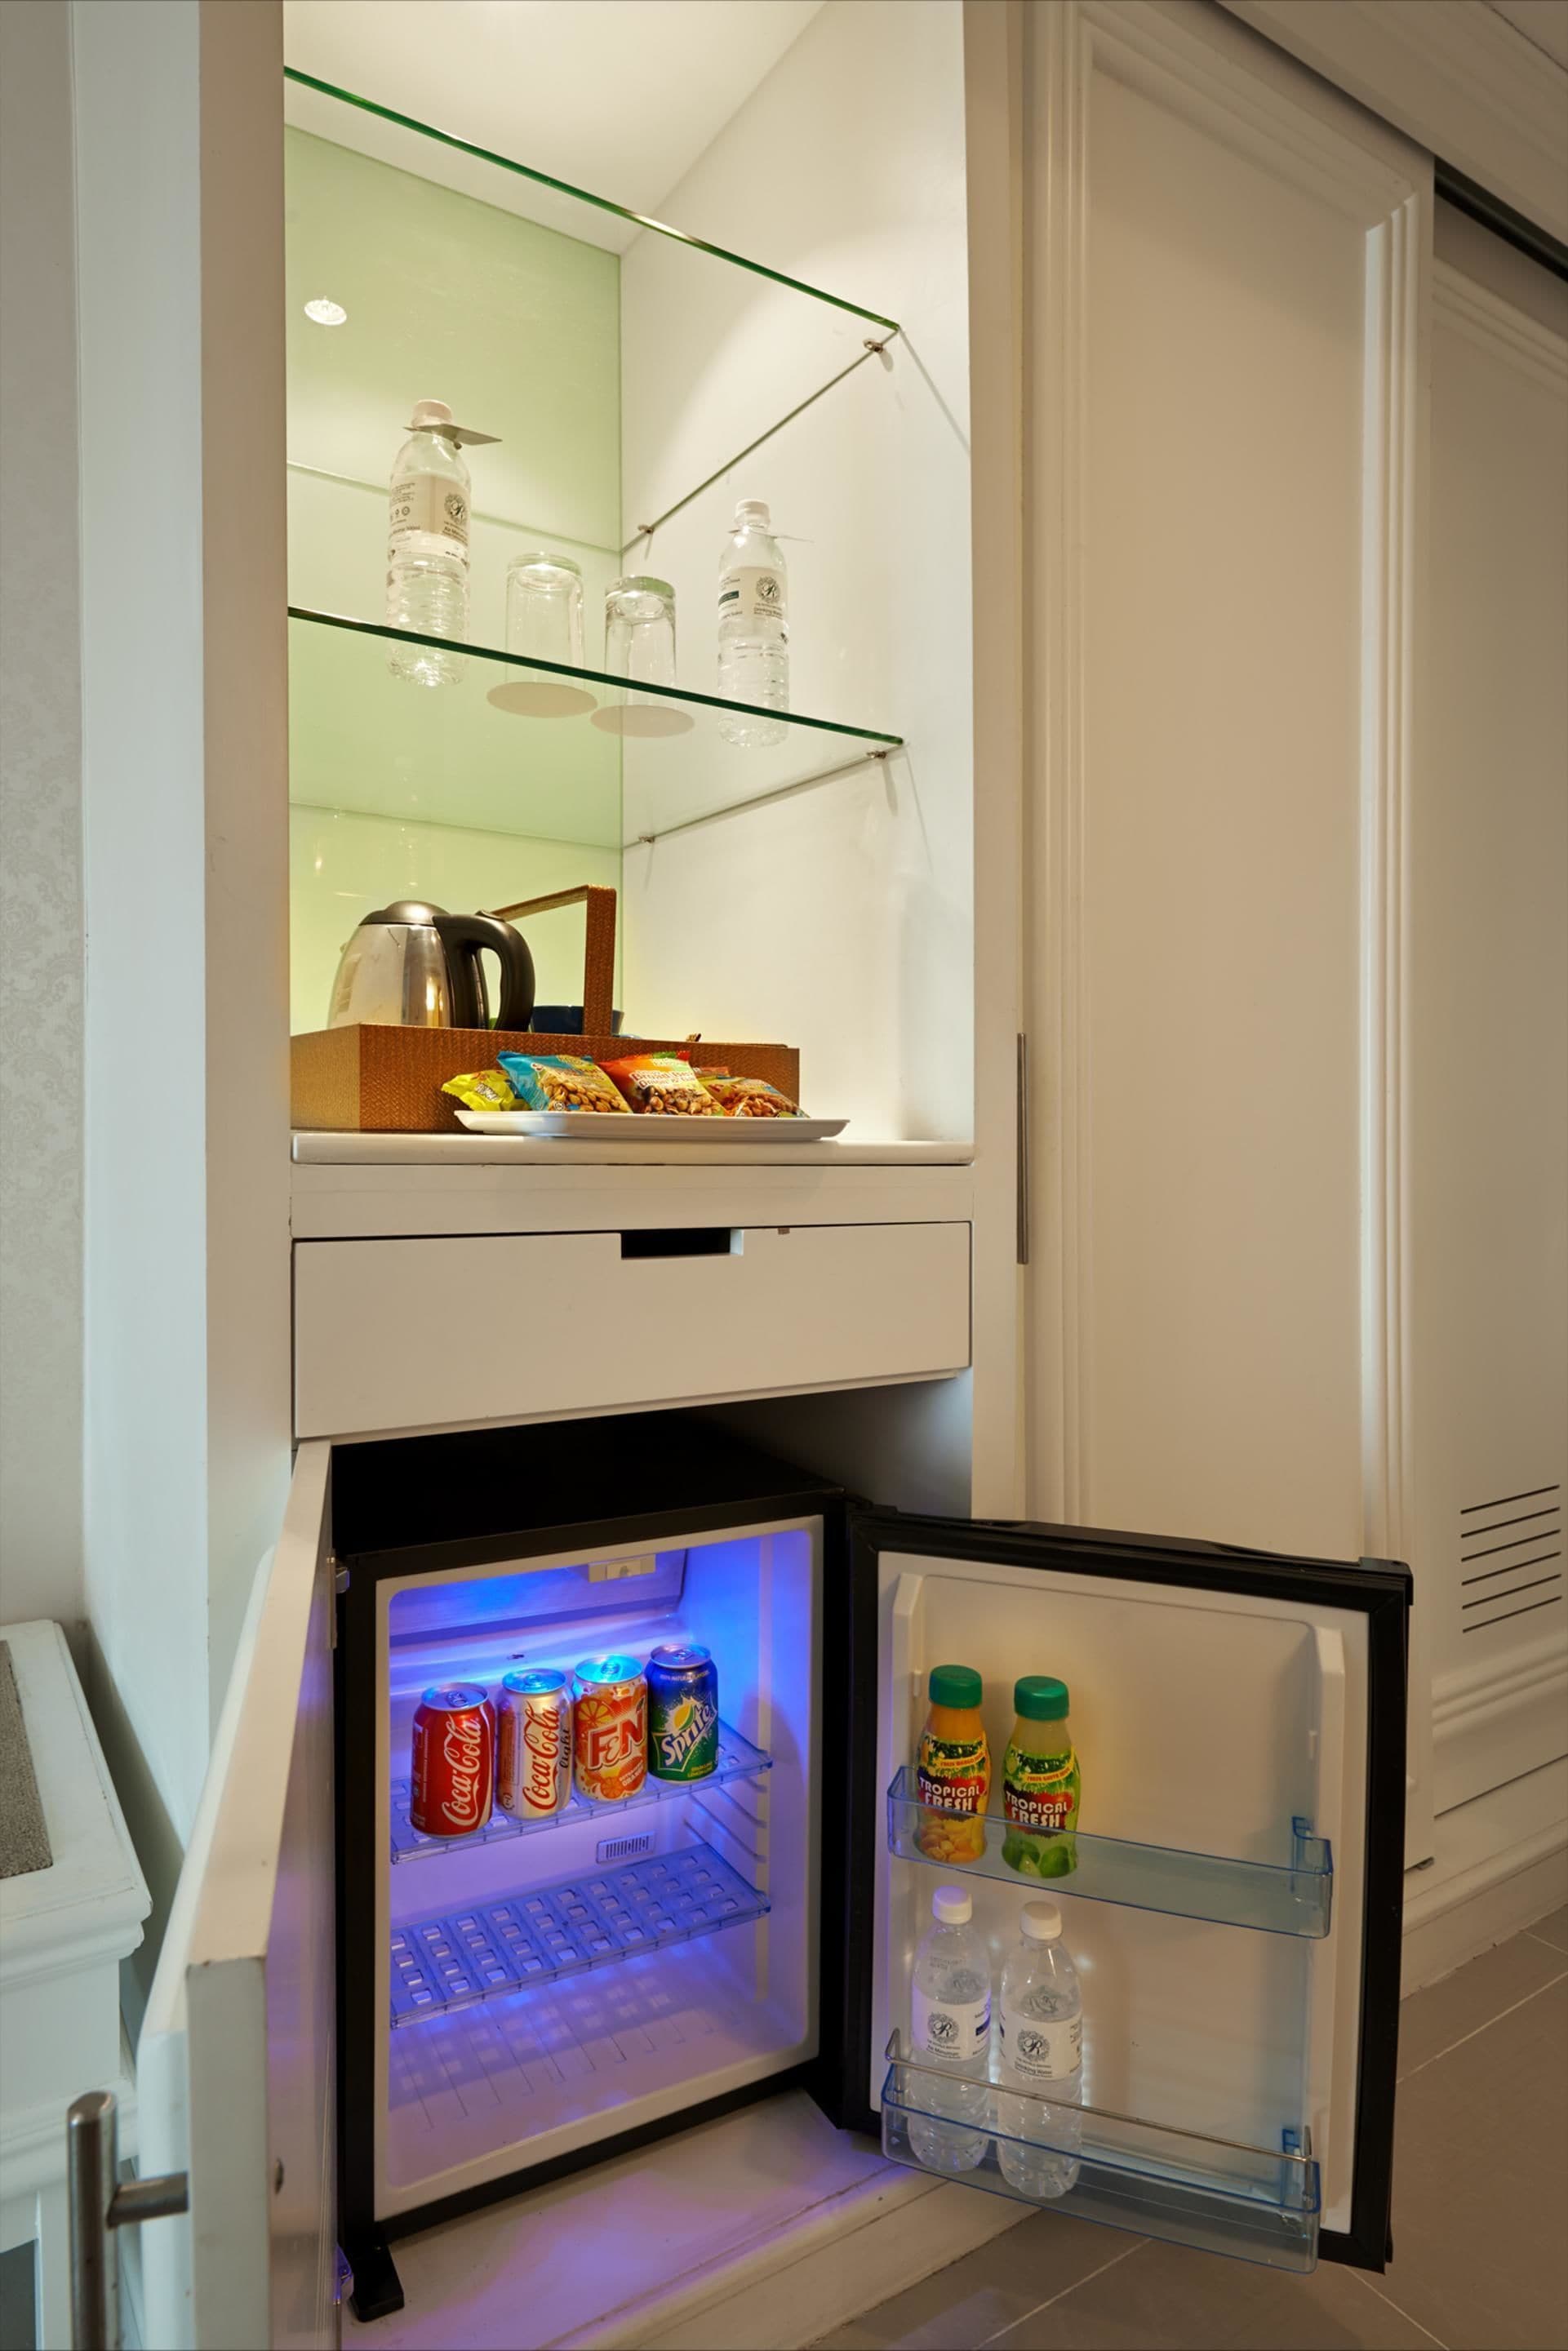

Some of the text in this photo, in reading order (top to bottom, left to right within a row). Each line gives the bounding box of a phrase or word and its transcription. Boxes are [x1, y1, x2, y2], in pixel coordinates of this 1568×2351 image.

[522, 1700, 560, 1810] Coca-Cola
[589, 1706, 644, 1770] F&N
[661, 1704, 713, 1767] Sprite
[442, 1712, 482, 1826] Coca-Cola
[919, 1776, 979, 1798] TROPICAL
[925, 1793, 973, 1811] FRESH
[1006, 1790, 1067, 1814] TROPICAL
[1011, 1807, 1060, 1828] FRESH
